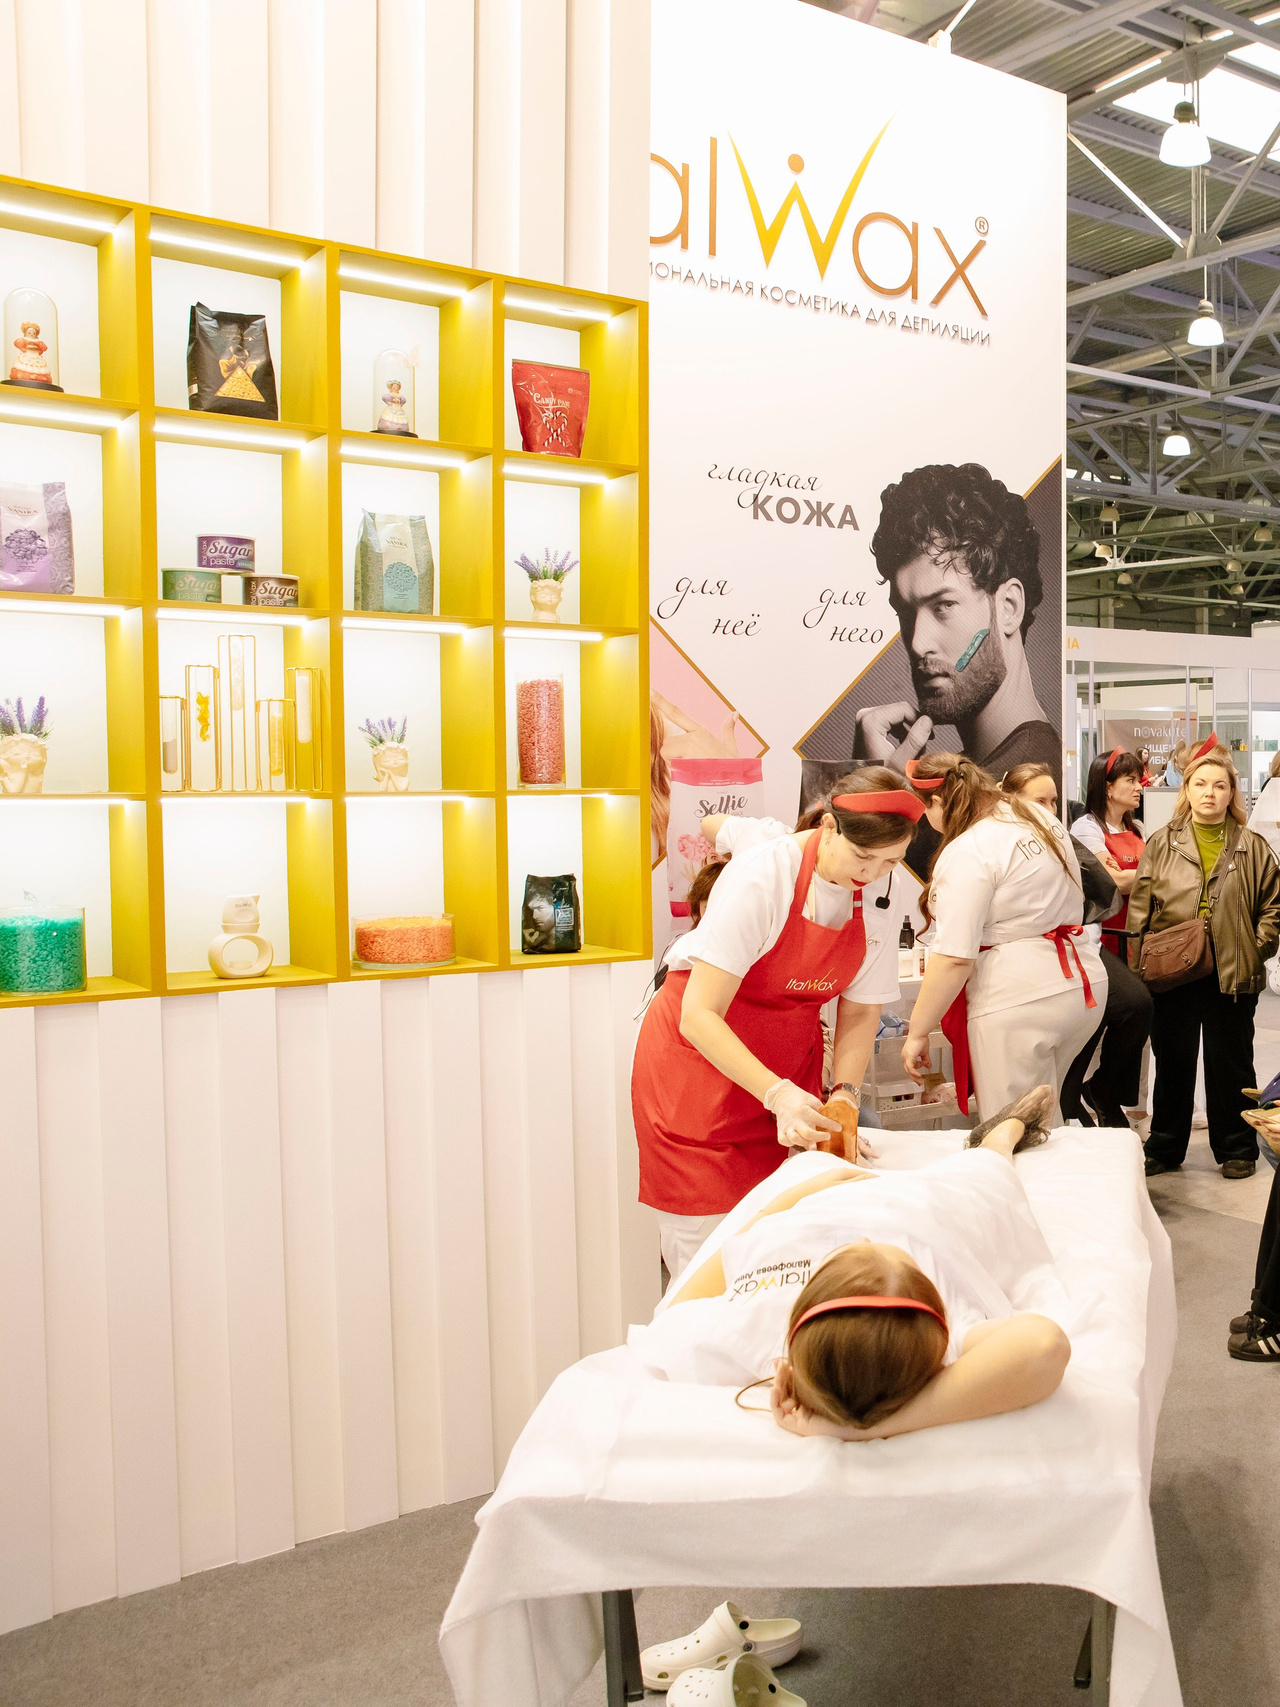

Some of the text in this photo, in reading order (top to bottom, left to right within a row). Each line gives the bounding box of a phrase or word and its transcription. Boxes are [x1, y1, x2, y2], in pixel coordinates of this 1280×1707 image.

[759, 284, 861, 319] КОСМЕТИКА
[865, 308, 897, 326] ДЛЯ
[901, 315, 991, 345] ДЕПИЛЯЦИИ
[707, 463, 823, 509] гладкая
[752, 493, 860, 531] КОЖА
[208, 540, 253, 559] Sugar
[209, 556, 236, 567] paste
[258, 581, 298, 600] Sugar
[656, 576, 734, 620] для
[802, 588, 871, 629] для
[711, 612, 762, 637] неё
[829, 624, 884, 644] него
[694, 794, 749, 819] Selfie
[785, 967, 837, 991] ItalWax
[756, 1259, 811, 1275] Малофеева
[729, 1270, 811, 1305] ItalWax
